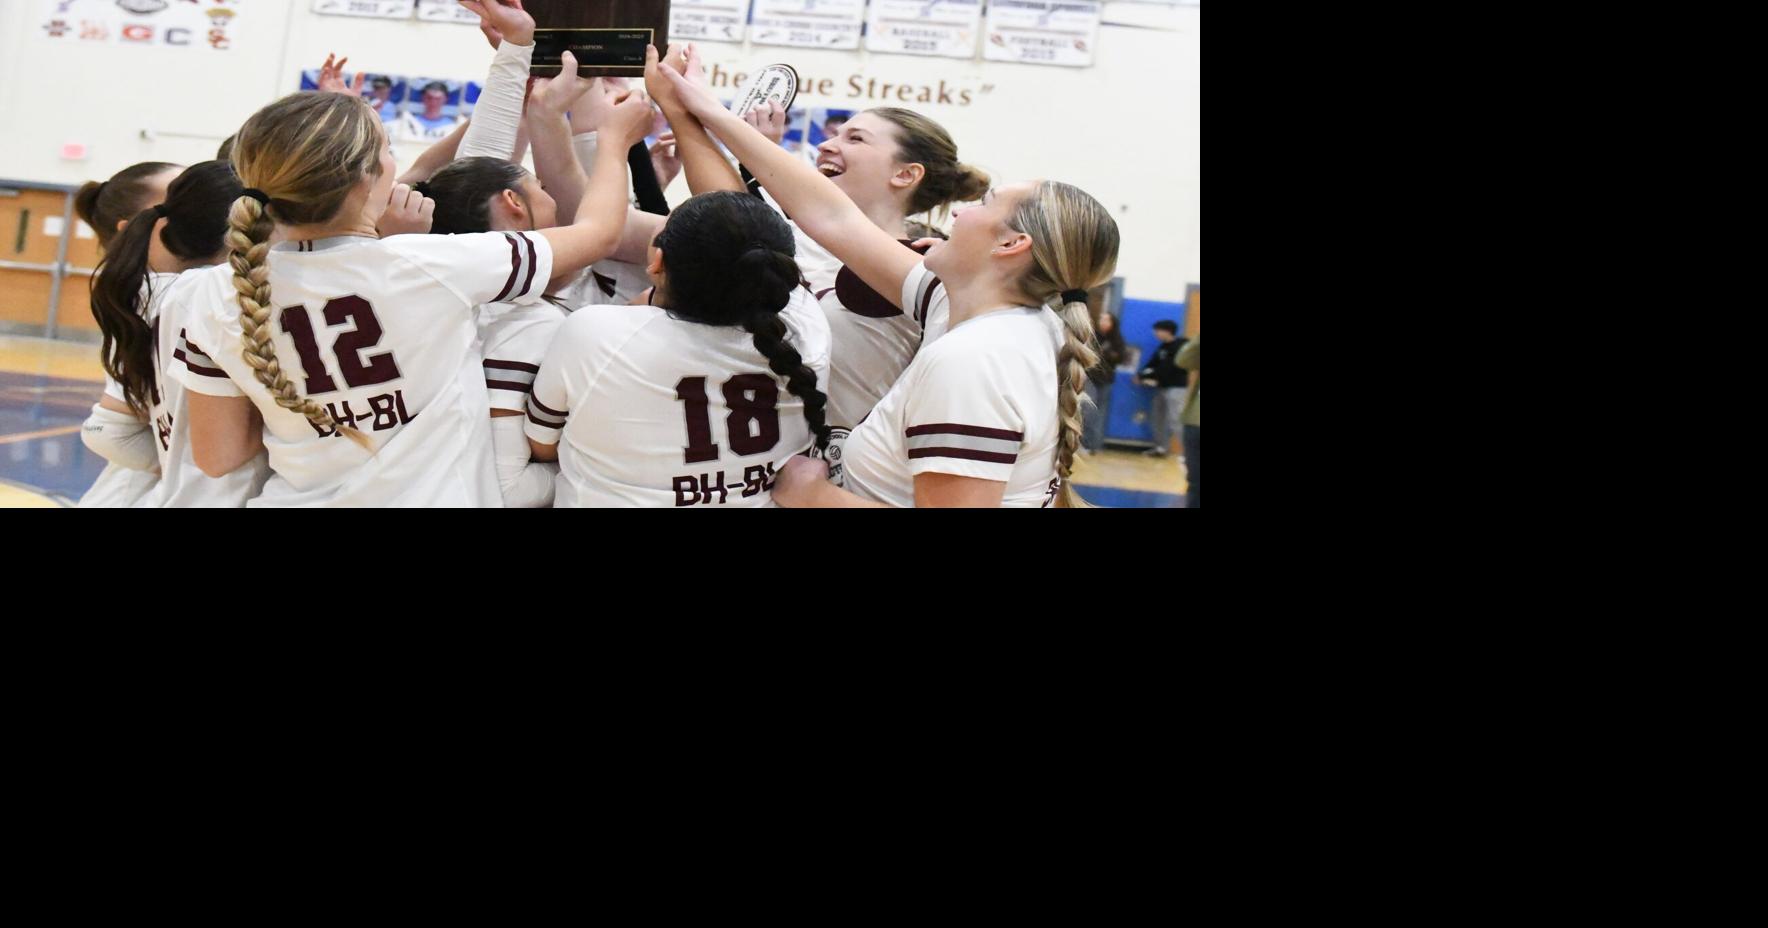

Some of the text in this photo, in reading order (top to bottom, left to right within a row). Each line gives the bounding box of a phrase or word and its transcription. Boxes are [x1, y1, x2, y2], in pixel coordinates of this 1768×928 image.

[702, 63, 748, 89] he
[280, 292, 402, 395] 12
[674, 373, 780, 464] 18
